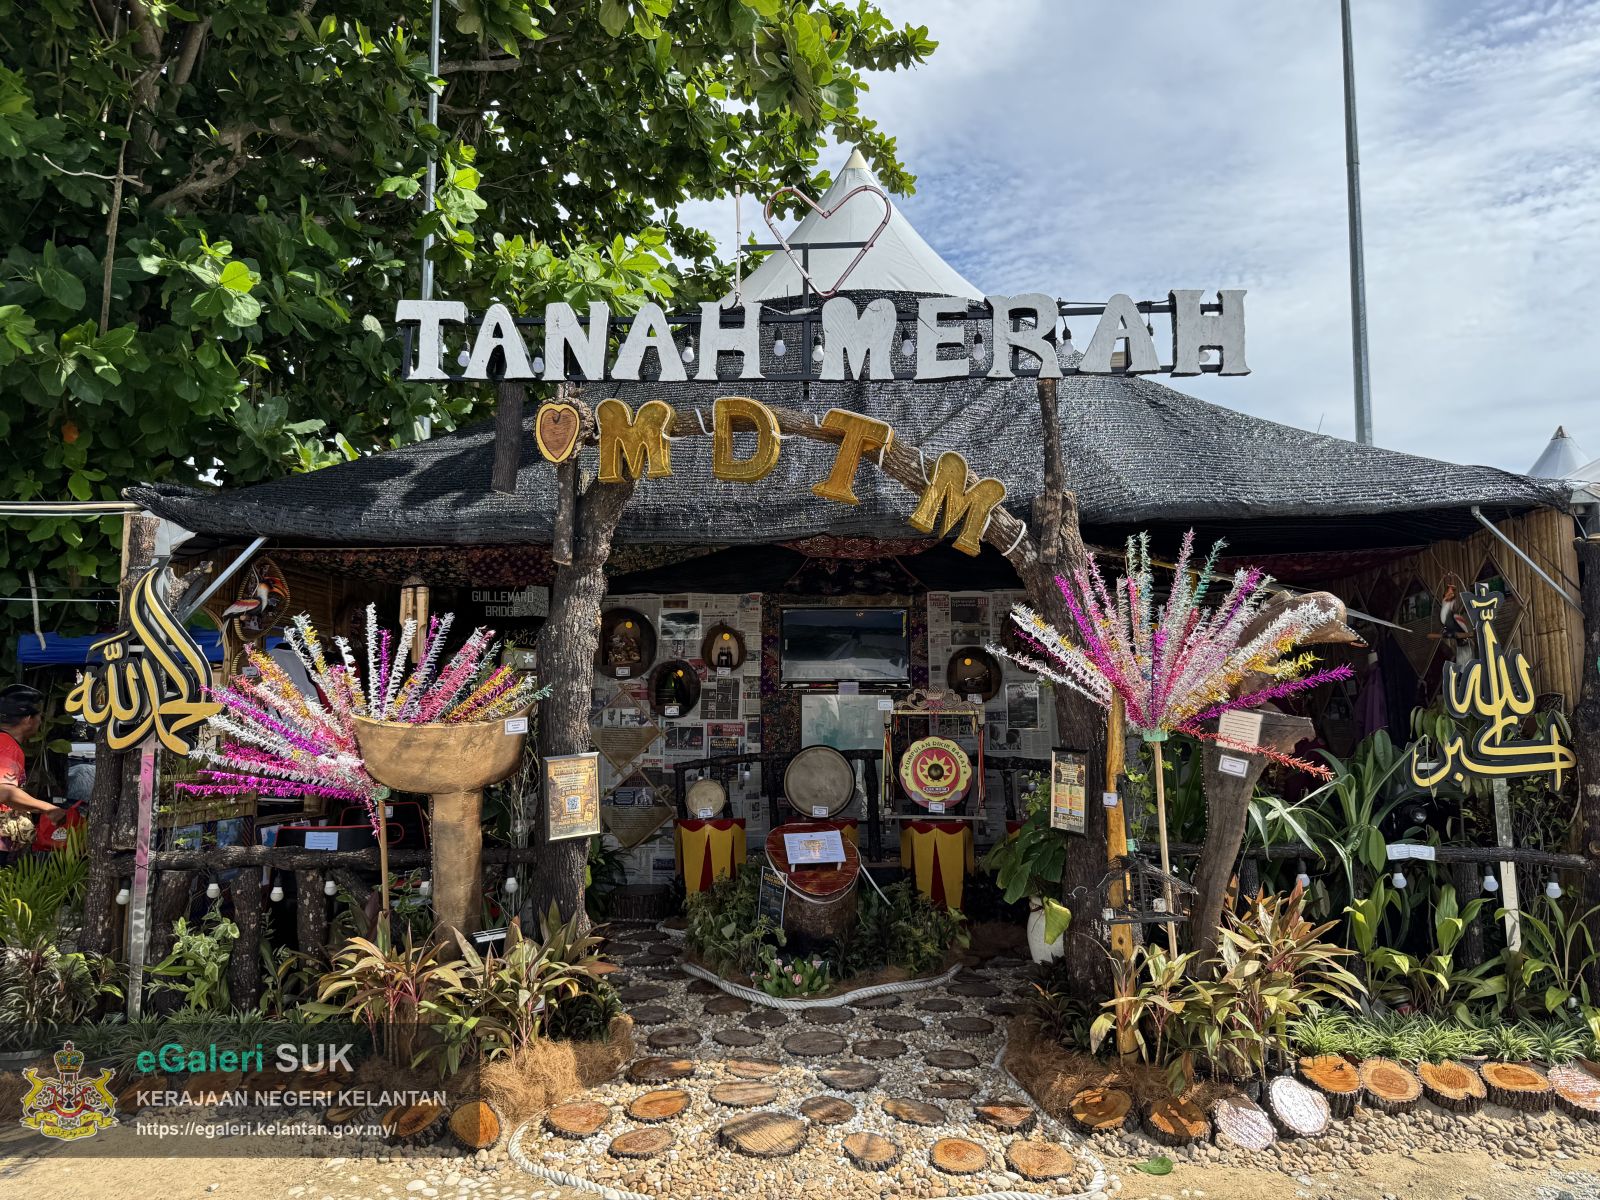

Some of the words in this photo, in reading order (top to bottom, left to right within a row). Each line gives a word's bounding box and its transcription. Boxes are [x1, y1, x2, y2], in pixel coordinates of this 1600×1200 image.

[395, 300, 766, 381] TANAH
[819, 289, 1252, 381] MERAH
[471, 590, 534, 603] GUILLEMARD
[485, 605, 521, 617] BRIDGE
[904, 741, 931, 770] KUMPULAN
[932, 741, 951, 749] DIKIR
[951, 747, 967, 769] BARAT
